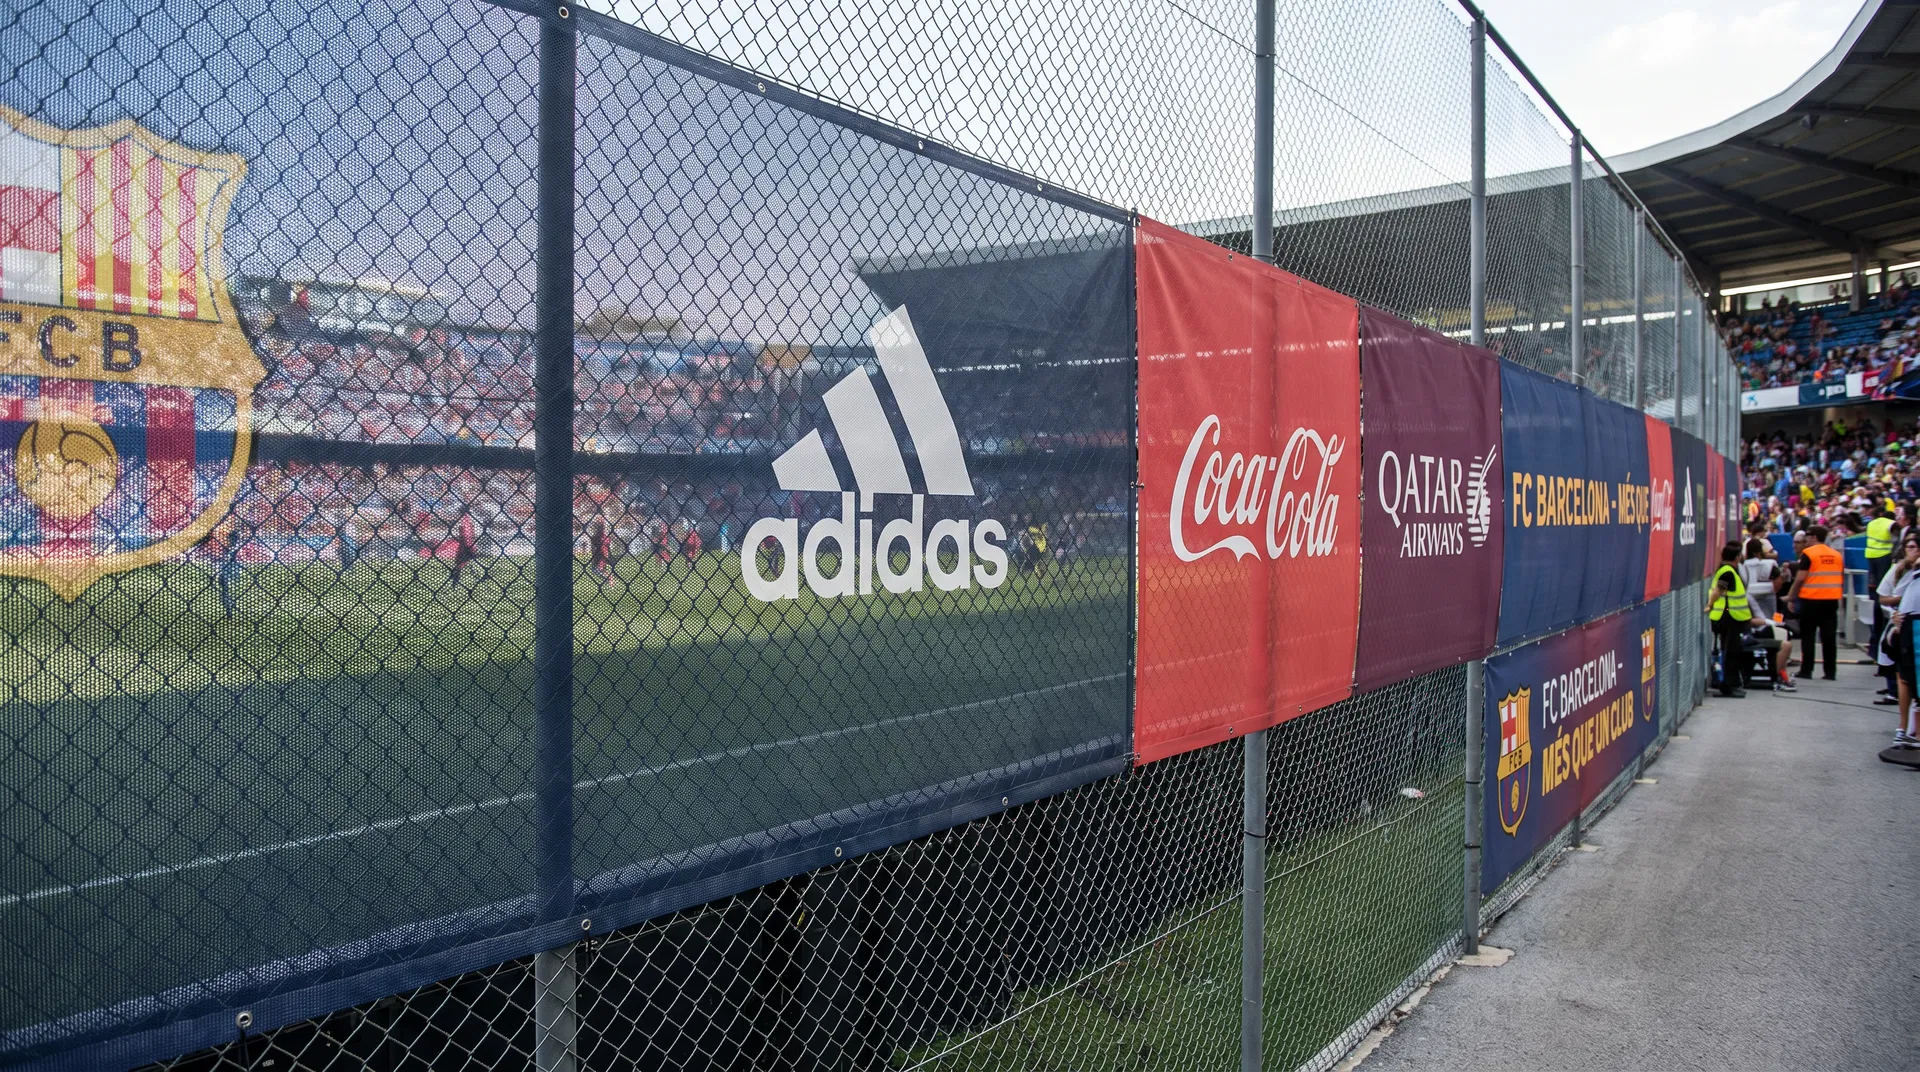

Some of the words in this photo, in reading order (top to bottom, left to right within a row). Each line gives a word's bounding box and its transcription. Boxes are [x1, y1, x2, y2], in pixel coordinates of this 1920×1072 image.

[1169, 414, 1346, 562] Coca-Cola
[1378, 450, 1464, 529] QATAR
[1512, 471, 1533, 528] FC
[1536, 474, 1610, 526] BARCELONA
[1617, 471, 1636, 525] MÉS
[741, 491, 1009, 602] adidas
[1400, 522, 1464, 558] AIRWAYS
[1542, 677, 1558, 729] FC
[1560, 649, 1617, 720] BARCELONA
[1541, 725, 1571, 797] MÉS
[1571, 716, 1595, 780] QUE
[1595, 705, 1609, 755] UN
[1610, 690, 1635, 742] CLUB
